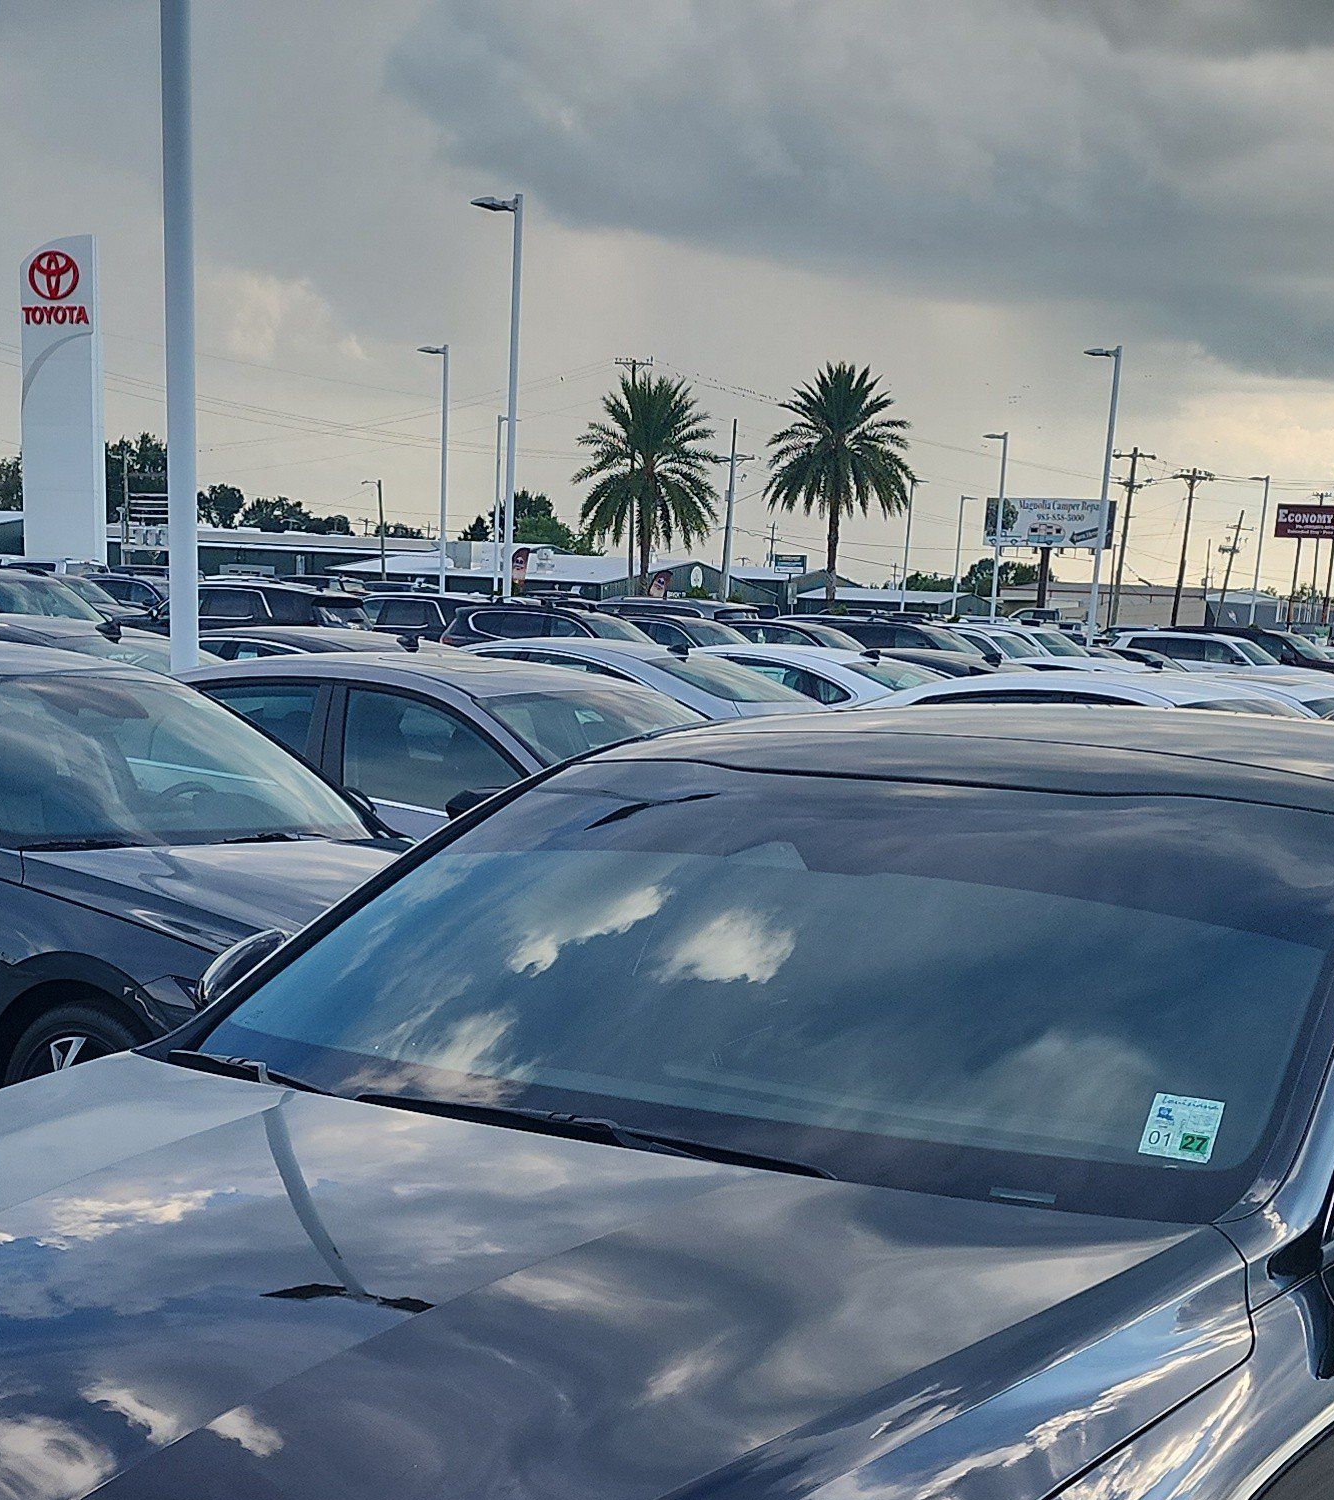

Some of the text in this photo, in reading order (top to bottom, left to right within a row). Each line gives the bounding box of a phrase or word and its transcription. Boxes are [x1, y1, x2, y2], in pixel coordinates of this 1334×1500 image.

[22, 306, 89, 325] TOYOTA
[1052, 500, 1079, 513] Camper
[1278, 509, 1333, 524] ECONOMY
[1148, 1130, 1208, 1151] 01 27
